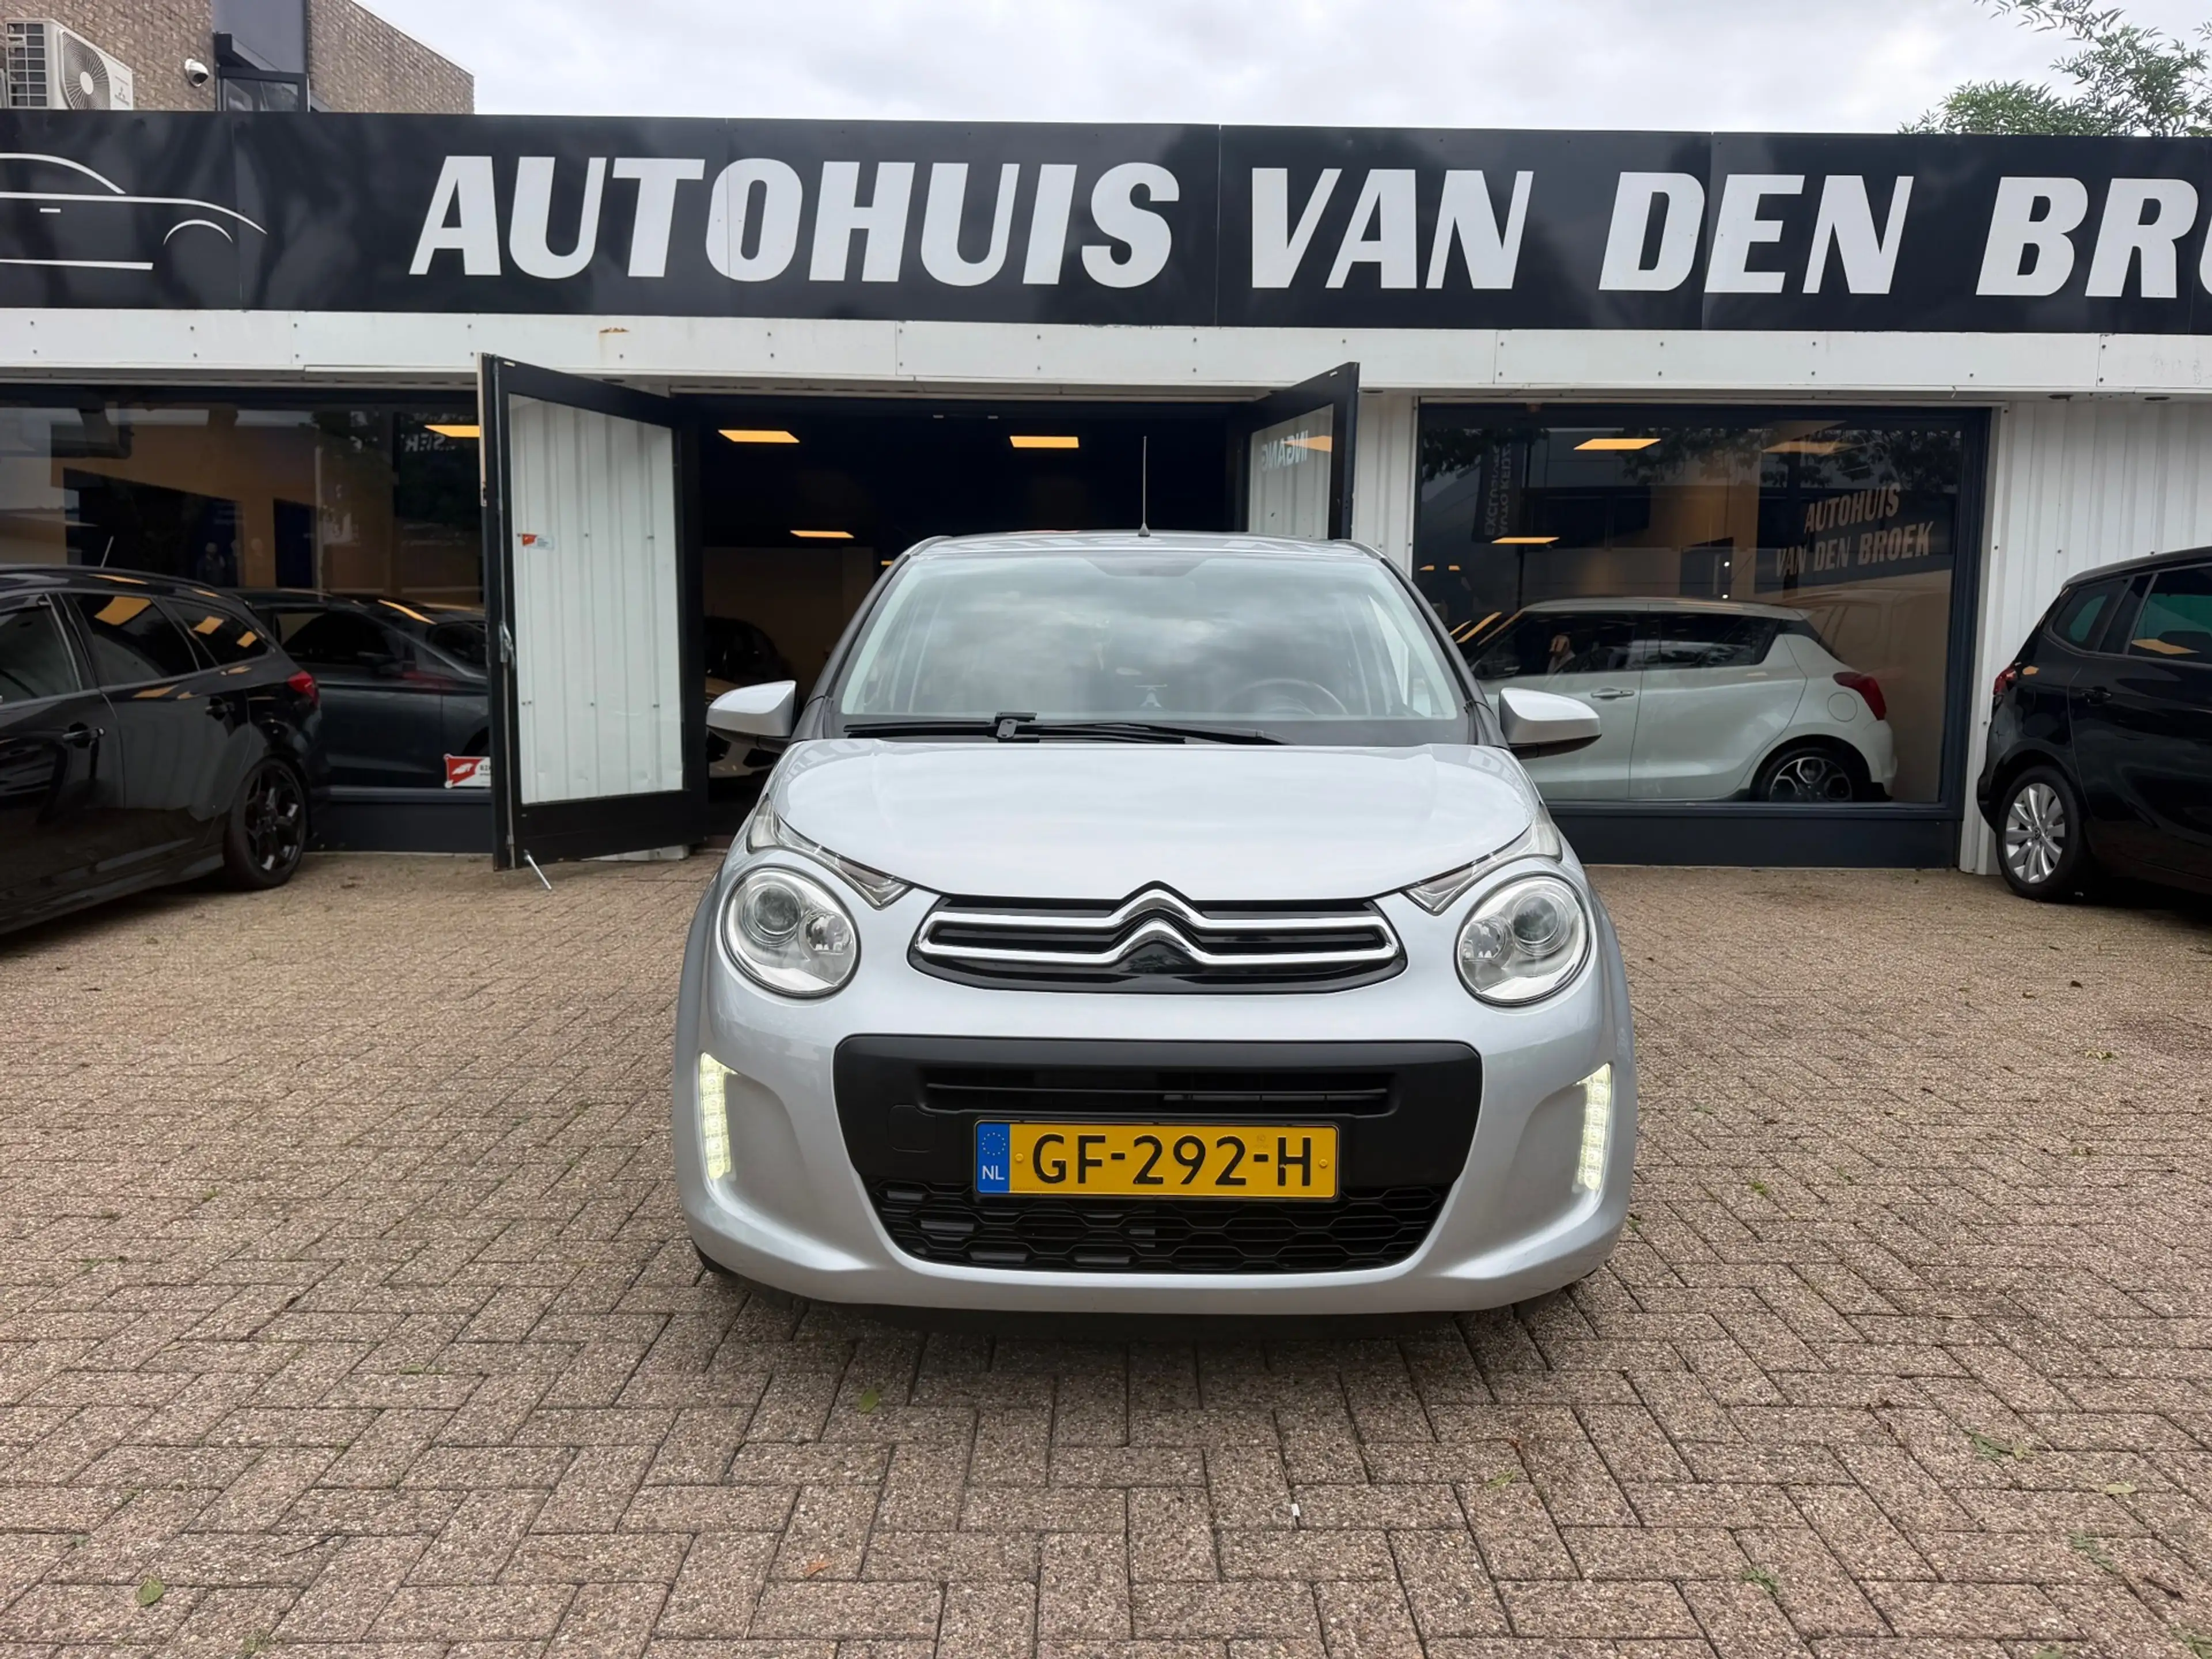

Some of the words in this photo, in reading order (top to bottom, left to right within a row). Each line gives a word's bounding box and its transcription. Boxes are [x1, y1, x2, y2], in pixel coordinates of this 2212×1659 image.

[410, 156, 1179, 288] AUTOHUIS
[1252, 168, 1533, 289] VAN
[1599, 172, 1914, 294] DEN
[1976, 177, 2212, 298] BR
[1804, 483, 1900, 533] AUTOHUIS
[1777, 545, 1807, 576] VAN
[1814, 536, 1851, 571] DEN
[1858, 521, 1934, 566] BROEK
[982, 1165, 1005, 1180] NL
[1033, 1134, 1311, 1187] GF-292-H
